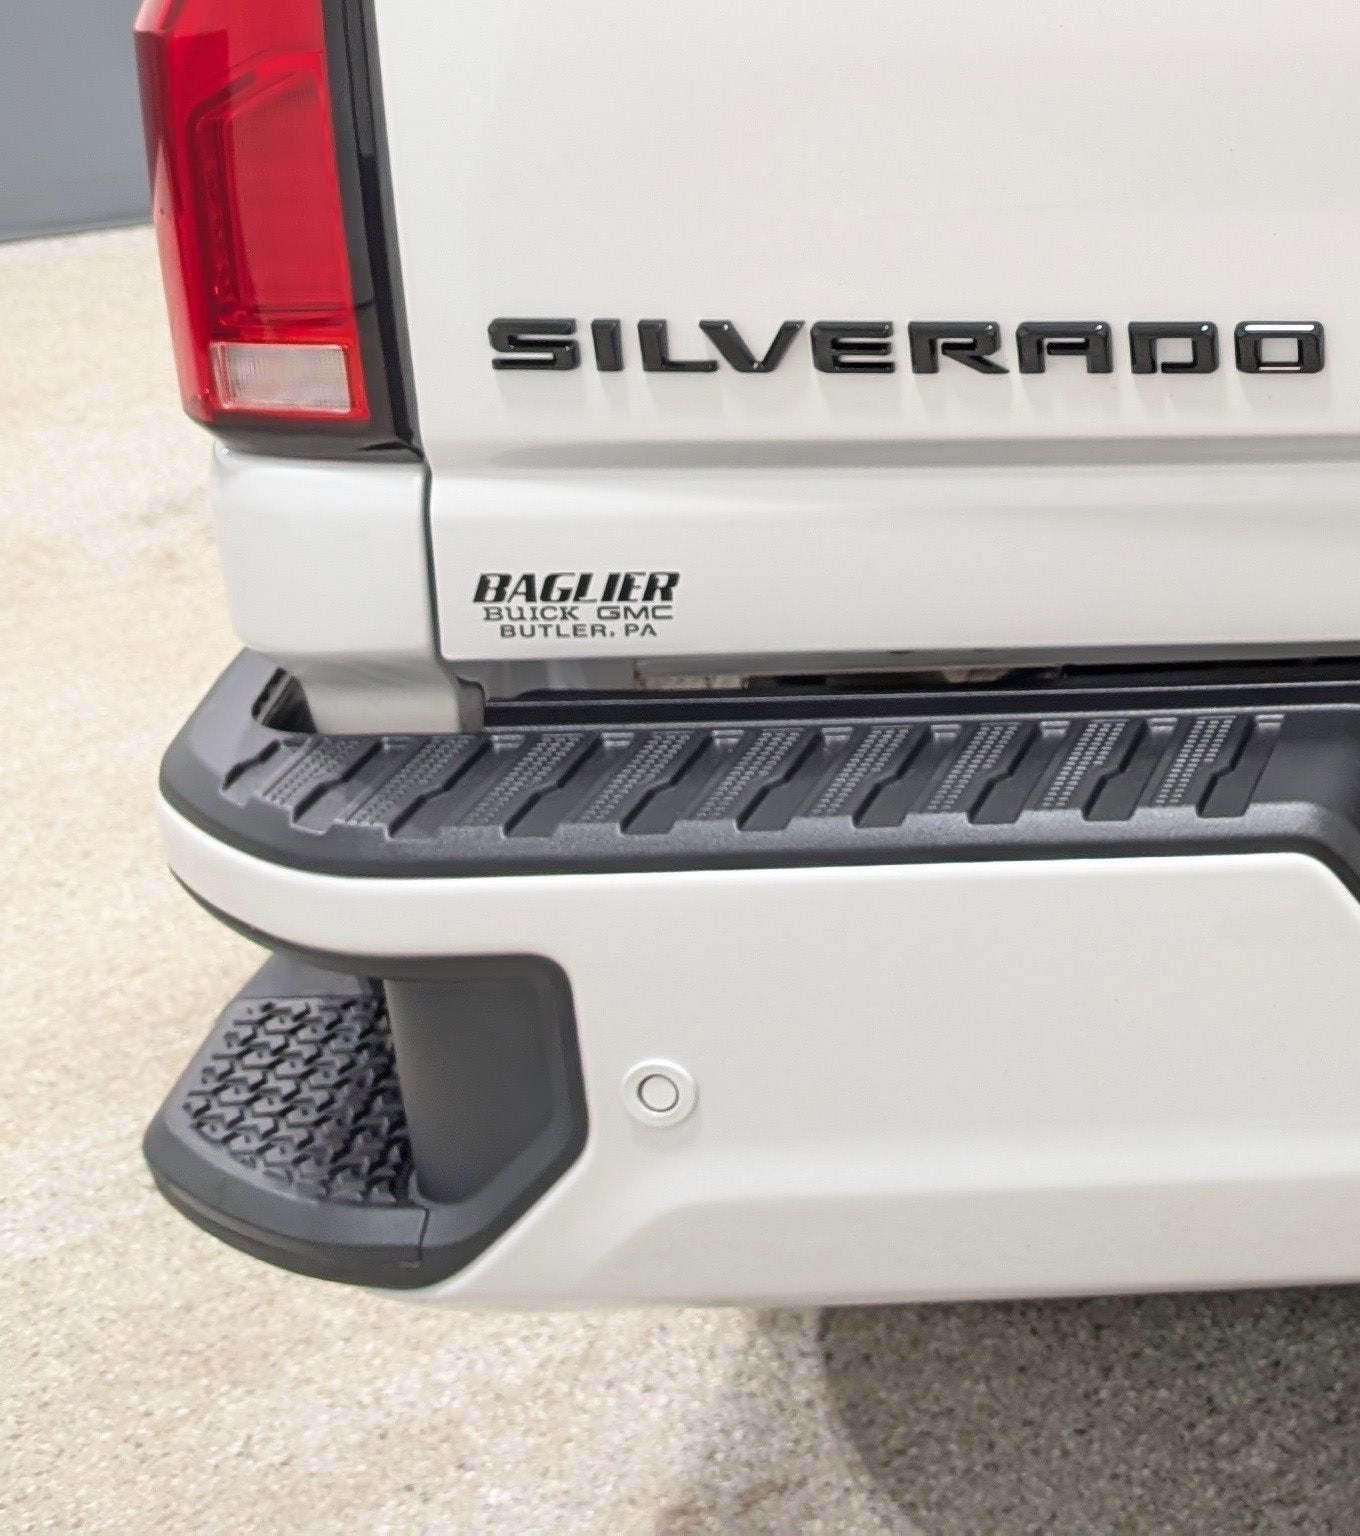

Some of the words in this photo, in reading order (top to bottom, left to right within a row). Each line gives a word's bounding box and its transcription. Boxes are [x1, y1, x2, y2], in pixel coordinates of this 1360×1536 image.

[487, 317, 1326, 375] SILVERADO
[473, 571, 681, 604] BAGLIER
[483, 605, 580, 622] BUICK
[596, 604, 674, 621] GMC
[624, 622, 658, 638] PA
